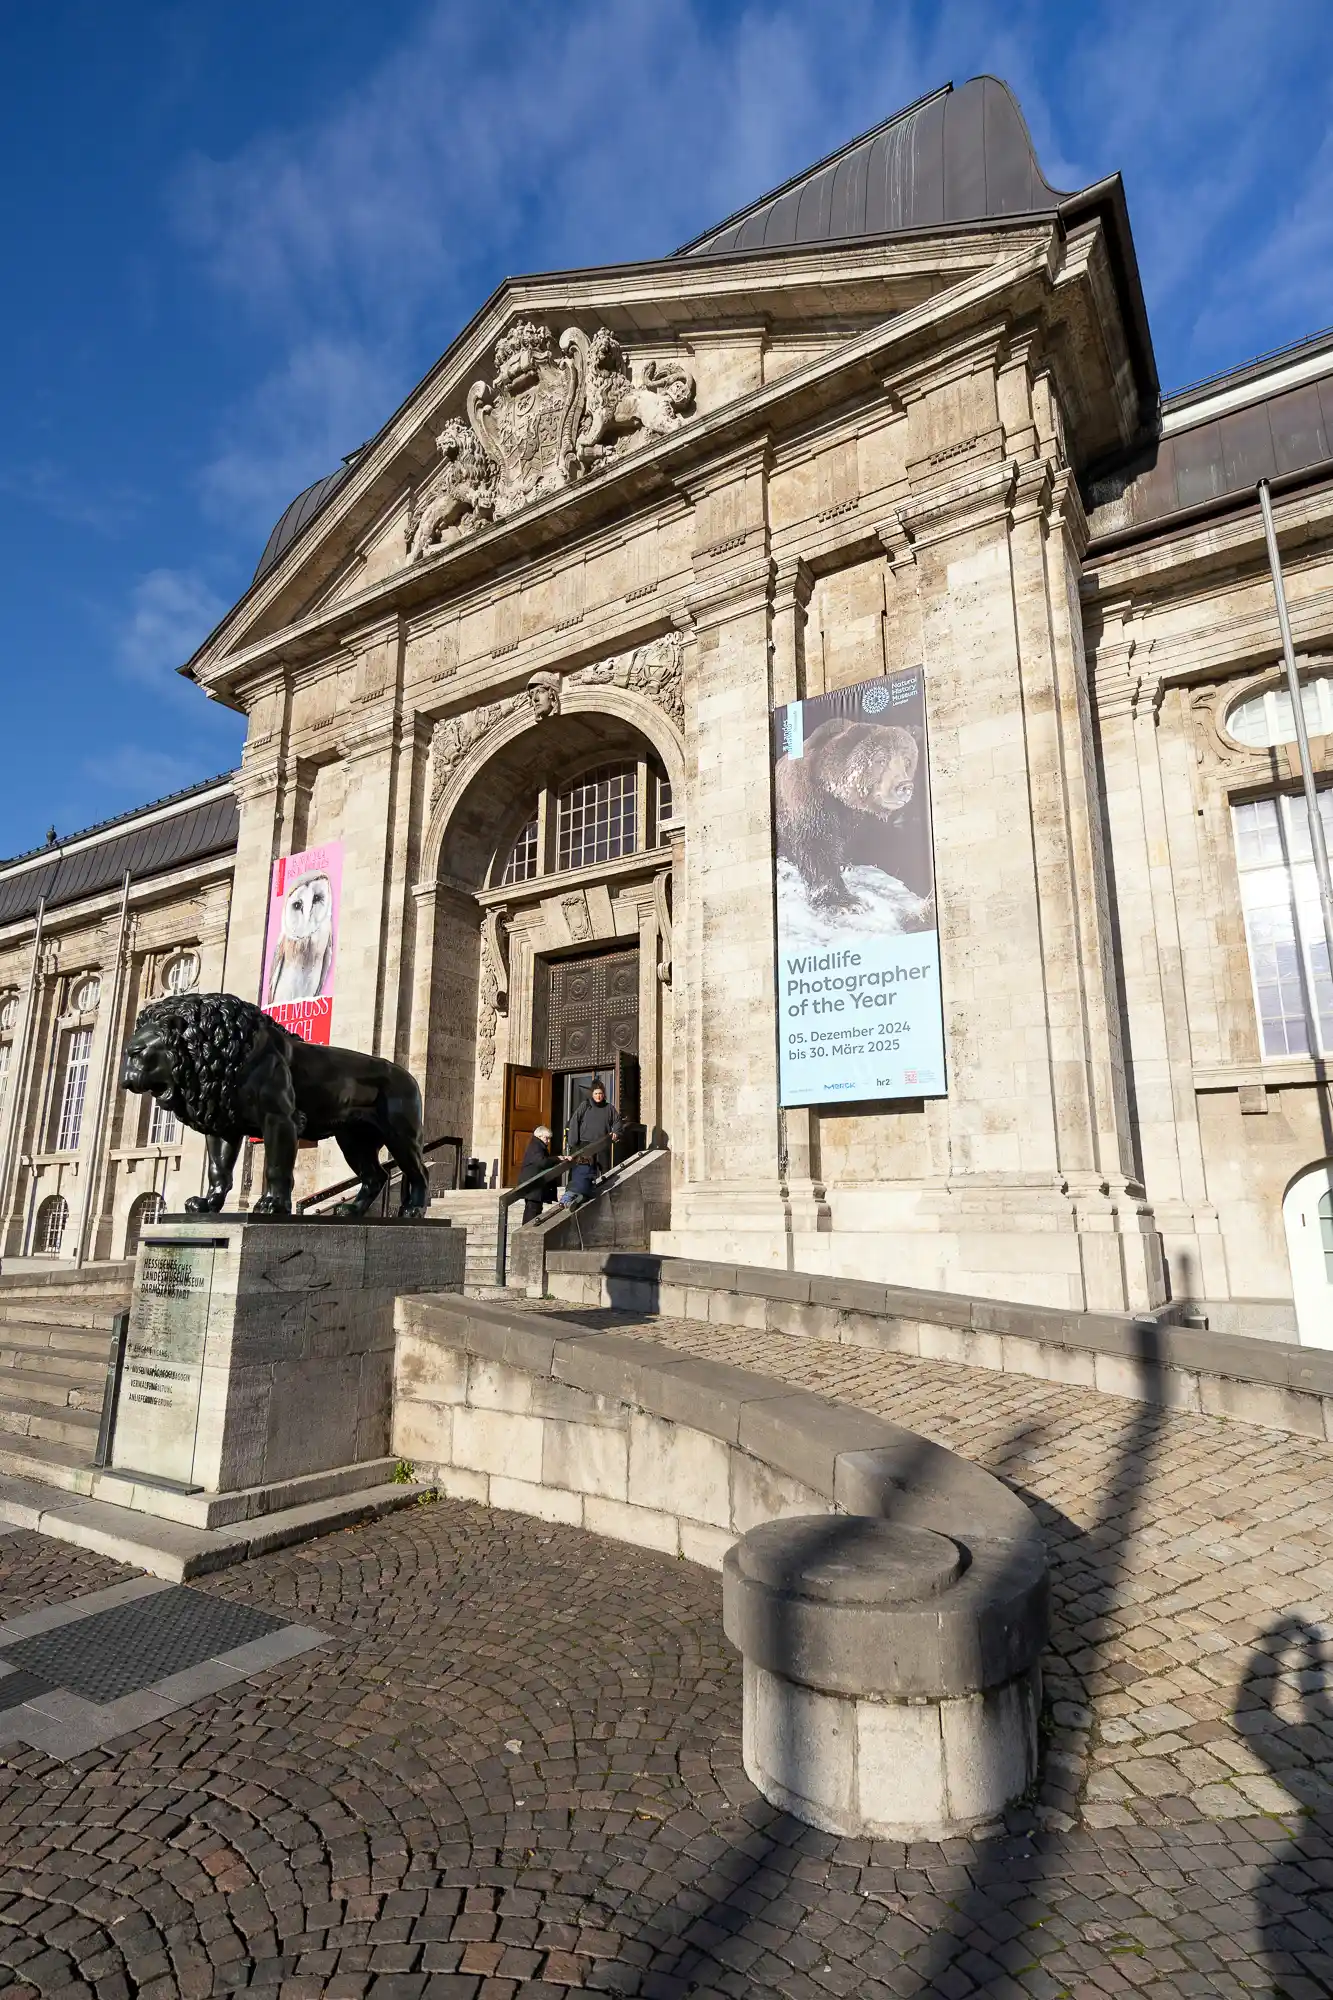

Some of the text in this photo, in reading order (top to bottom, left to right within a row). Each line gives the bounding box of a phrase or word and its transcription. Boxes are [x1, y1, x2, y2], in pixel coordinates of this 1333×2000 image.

[892, 676, 917, 689] Natural
[892, 684, 917, 695] History
[892, 690, 918, 701] Museum
[787, 950, 862, 975] Wildlife
[787, 964, 931, 996] Photographer
[290, 998, 329, 1020] MUSS
[788, 991, 897, 1017] of the Year
[788, 1021, 911, 1044] 05. Dezember 2024
[789, 1039, 900, 1060] bis 30. März 2025
[876, 1078, 891, 1087] hr2
